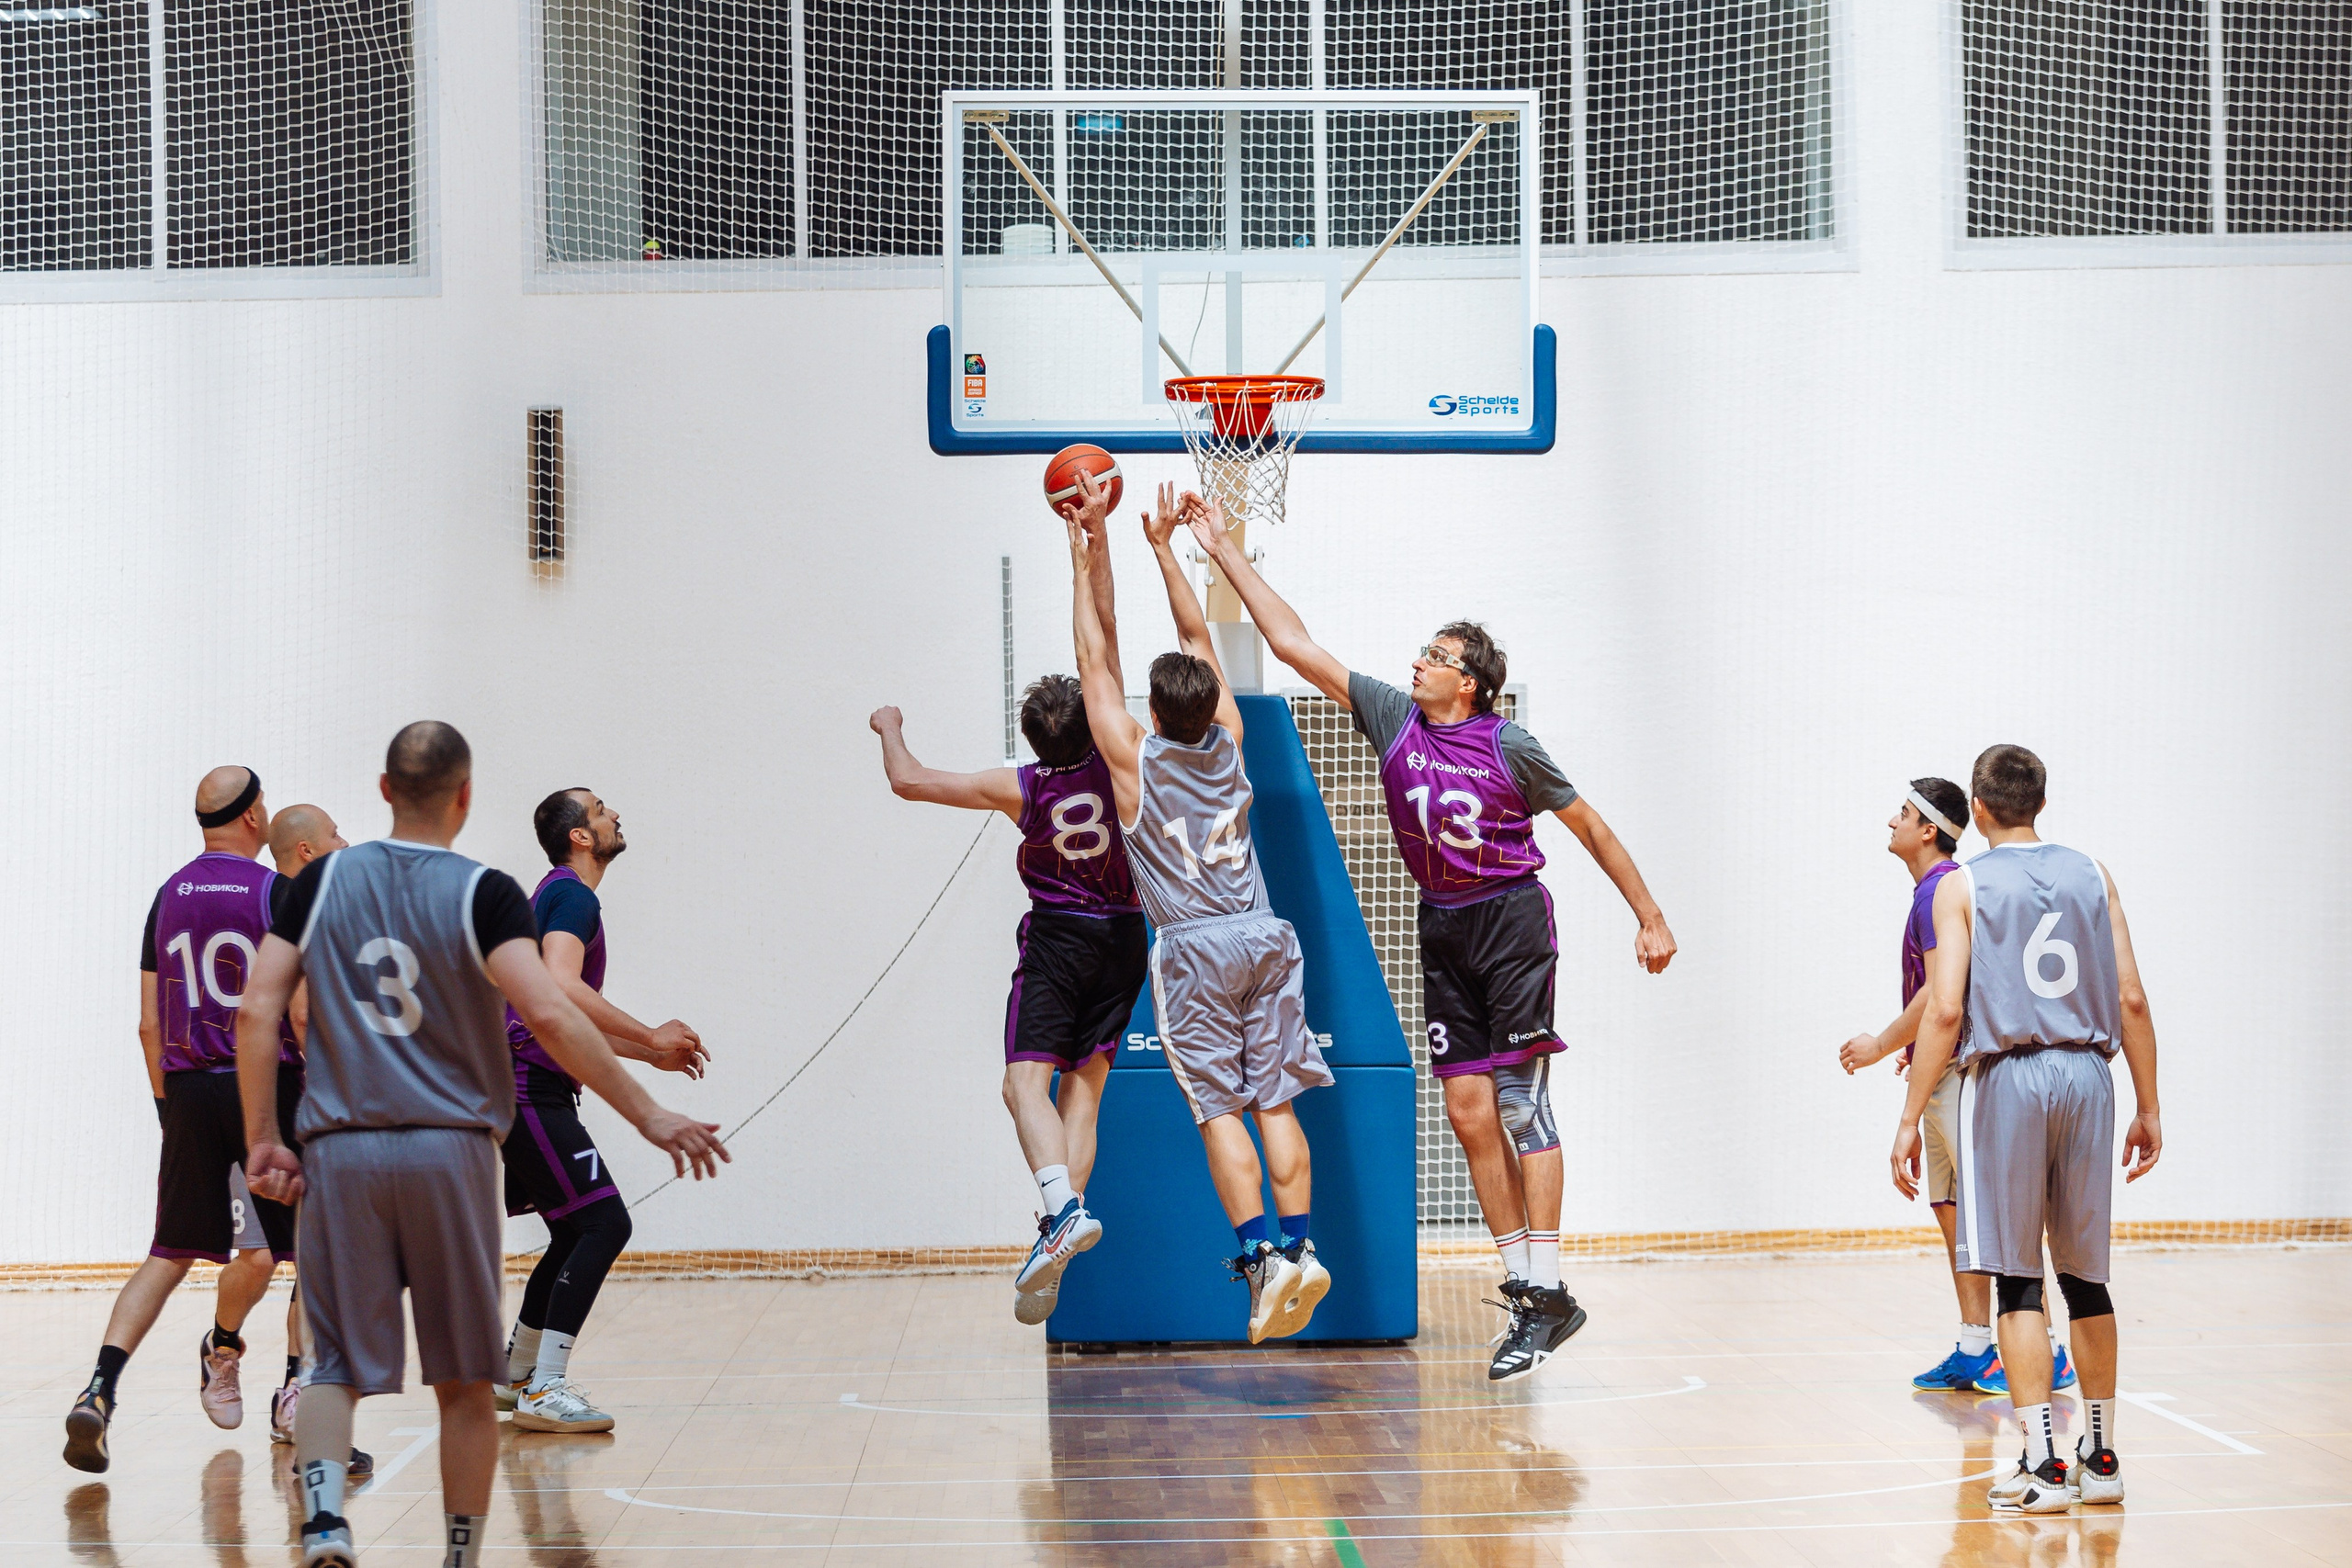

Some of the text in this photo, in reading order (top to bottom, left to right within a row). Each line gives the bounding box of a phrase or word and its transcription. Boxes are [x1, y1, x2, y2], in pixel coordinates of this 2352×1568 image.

[967, 378, 983, 388] FIBA
[1458, 395, 1520, 405] Schelde
[1458, 404, 1520, 417] Sports
[1050, 792, 1110, 862] 8
[1406, 785, 1484, 850] 13
[1162, 807, 1246, 880] 14
[195, 884, 249, 895] НОВИКОМ
[166, 931, 258, 1008] 10
[2023, 912, 2079, 998] 6
[355, 937, 424, 1037] 3
[1428, 1021, 1449, 1055] 3
[1520, 1028, 1548, 1041] НОВИКО
[573, 1148, 598, 1182] 7
